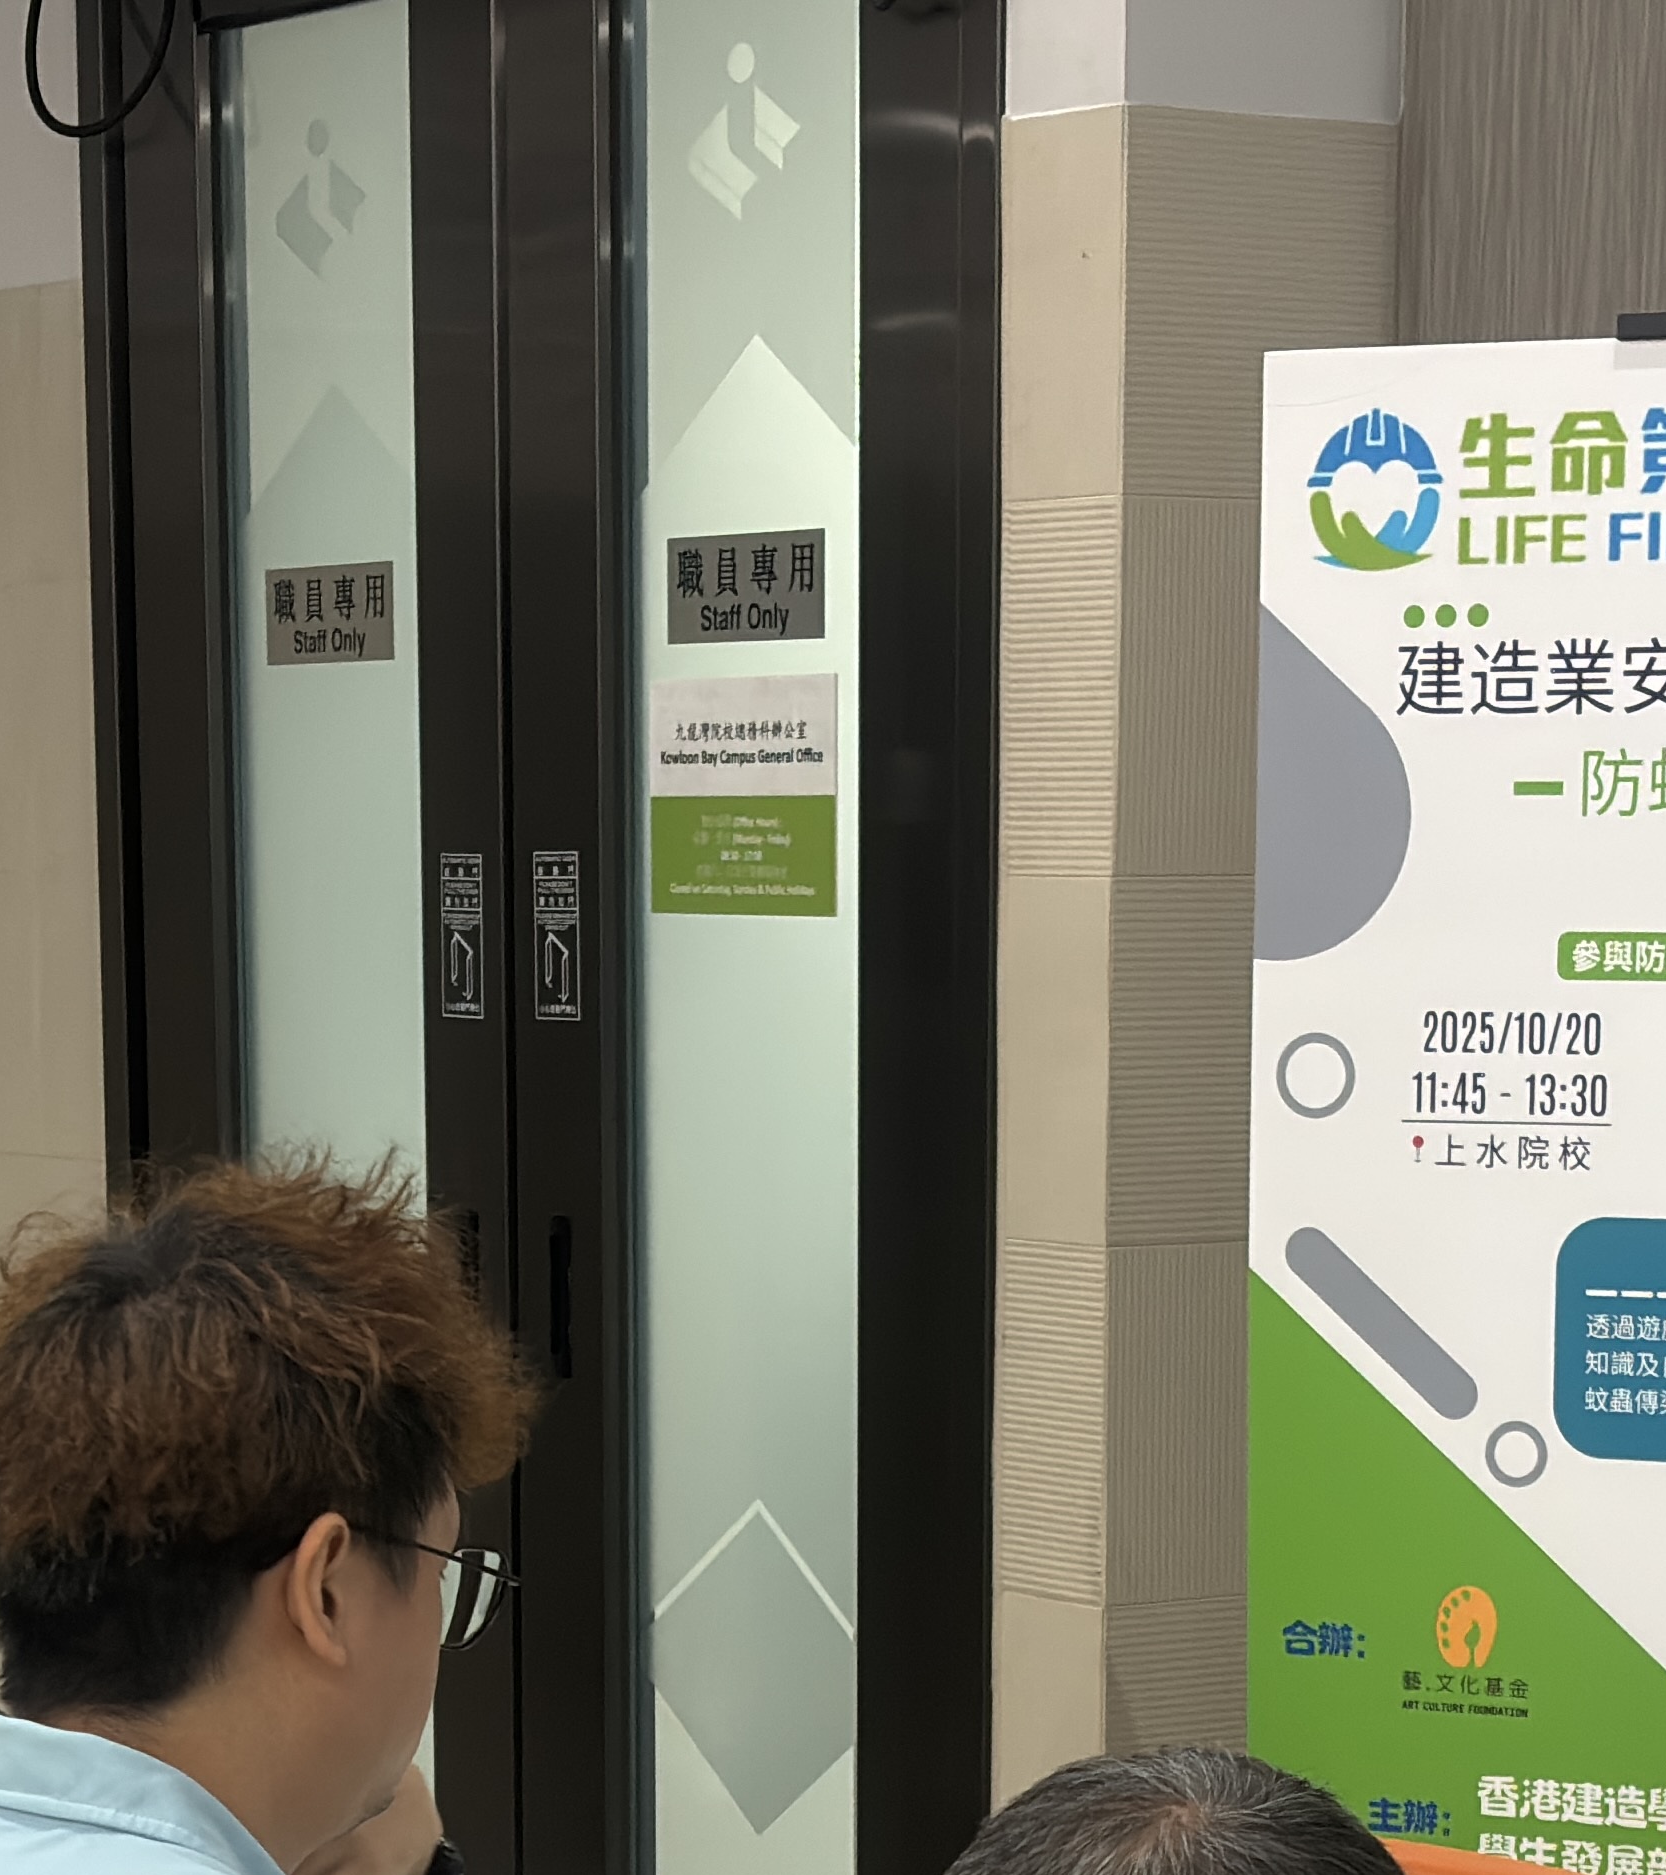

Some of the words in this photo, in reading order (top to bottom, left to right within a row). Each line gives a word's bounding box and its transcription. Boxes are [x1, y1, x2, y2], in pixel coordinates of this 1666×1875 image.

[1456, 514, 1587, 567] LIFE
[677, 543, 815, 599] 職員專用
[273, 574, 385, 624] 職員專用
[701, 604, 741, 632] Staff
[748, 602, 789, 636] Only
[294, 629, 326, 654] Staff
[331, 626, 366, 658] Only
[661, 751, 699, 765] Kowloon
[702, 750, 718, 768] Bay
[720, 750, 756, 767] Campus
[758, 748, 794, 764] General
[796, 747, 823, 763] Office
[1423, 1010, 1603, 1057] 2025/10/20
[1411, 1071, 1487, 1115] 11:45
[1525, 1073, 1609, 1118] 13:30
[1434, 1133, 1592, 1172] 上水院校
[1282, 1619, 1366, 1659] 合辦:
[1402, 1700, 1419, 1710] ART
[1423, 1701, 1464, 1714] CULTURE
[1468, 1704, 1529, 1718] FOUNDATION
